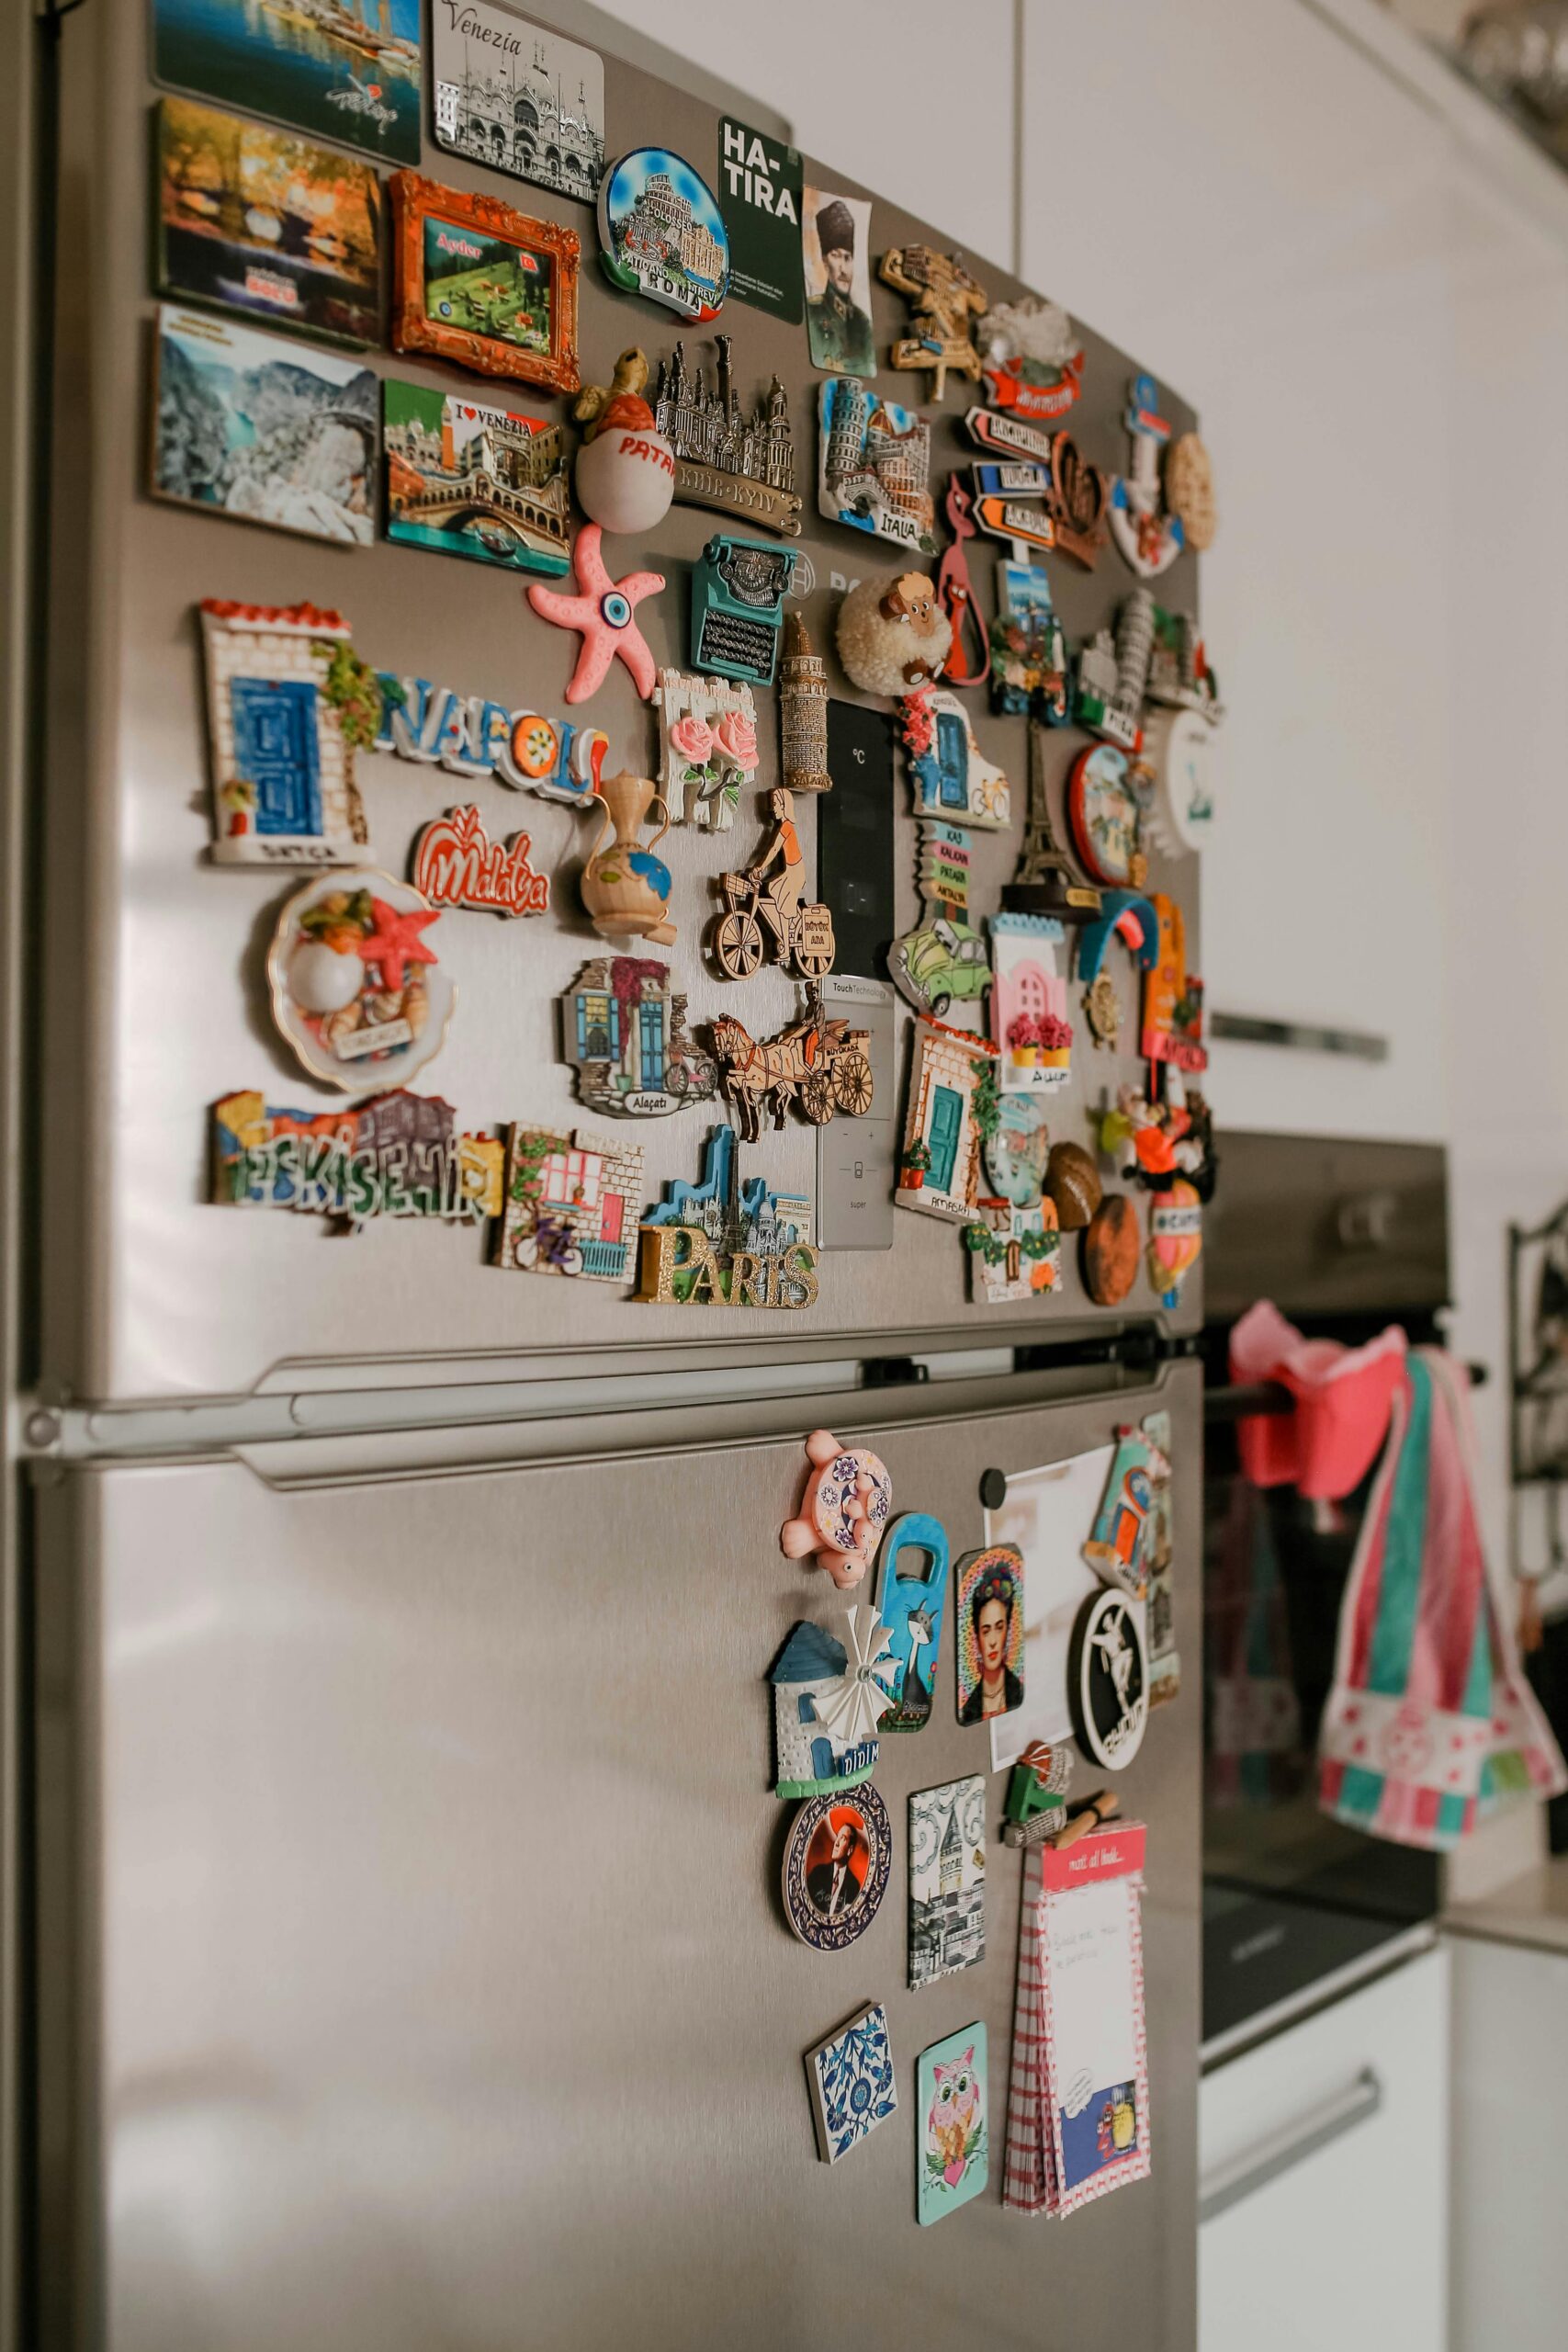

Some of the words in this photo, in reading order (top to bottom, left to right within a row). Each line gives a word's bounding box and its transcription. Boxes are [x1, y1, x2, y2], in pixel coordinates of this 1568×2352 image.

[441, 0, 522, 55] Venezia
[724, 121, 780, 175] HA-
[724, 159, 797, 225] TIRA
[437, 232, 482, 259] Ayder
[648, 273, 702, 311] ROMA
[478, 411, 532, 437] VENEZIA
[733, 484, 775, 513] KYIV
[881, 513, 917, 540] ITALIA
[940, 845, 968, 866] KALKAN
[426, 833, 547, 910] Malatya
[811, 935, 825, 944] ADA
[827, 1044, 860, 1057] BÜYÜKADA
[633, 1095, 667, 1112] Alaçatı
[850, 1200, 866, 1209] super
[640, 1224, 818, 1309] PARIS
